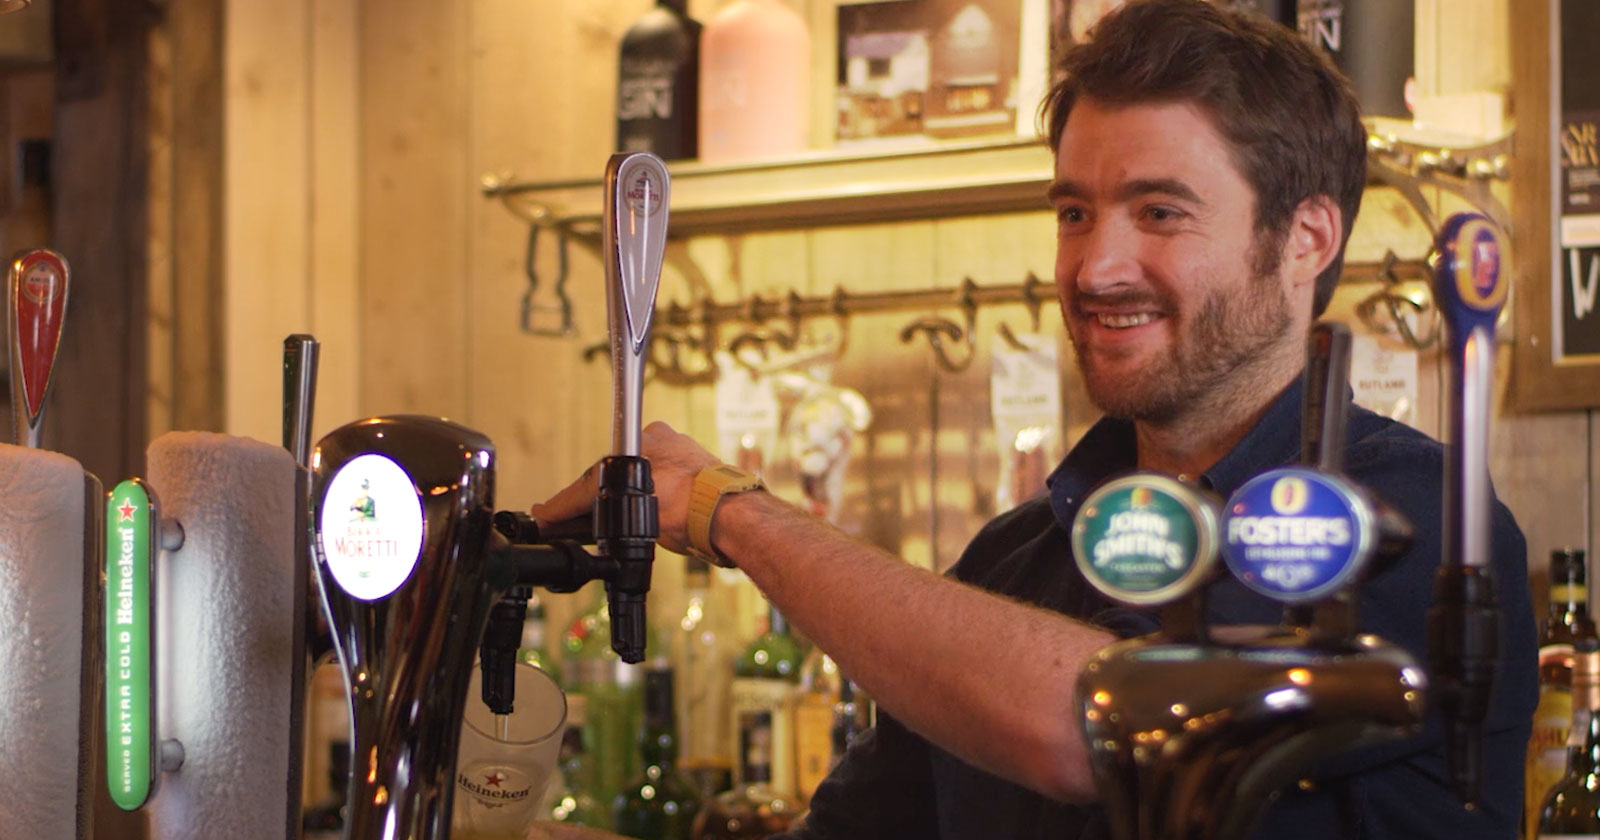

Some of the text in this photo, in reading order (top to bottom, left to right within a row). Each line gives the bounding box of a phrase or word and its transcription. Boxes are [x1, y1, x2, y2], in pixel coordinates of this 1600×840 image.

[618, 86, 670, 119] GIN
[627, 191, 659, 200] MORTTI
[1104, 510, 1169, 536] JOHN
[335, 537, 398, 557] MORETTI
[116, 527, 134, 793] SERVED EXTRA COLD Heineken
[458, 773, 530, 799] Heineken
